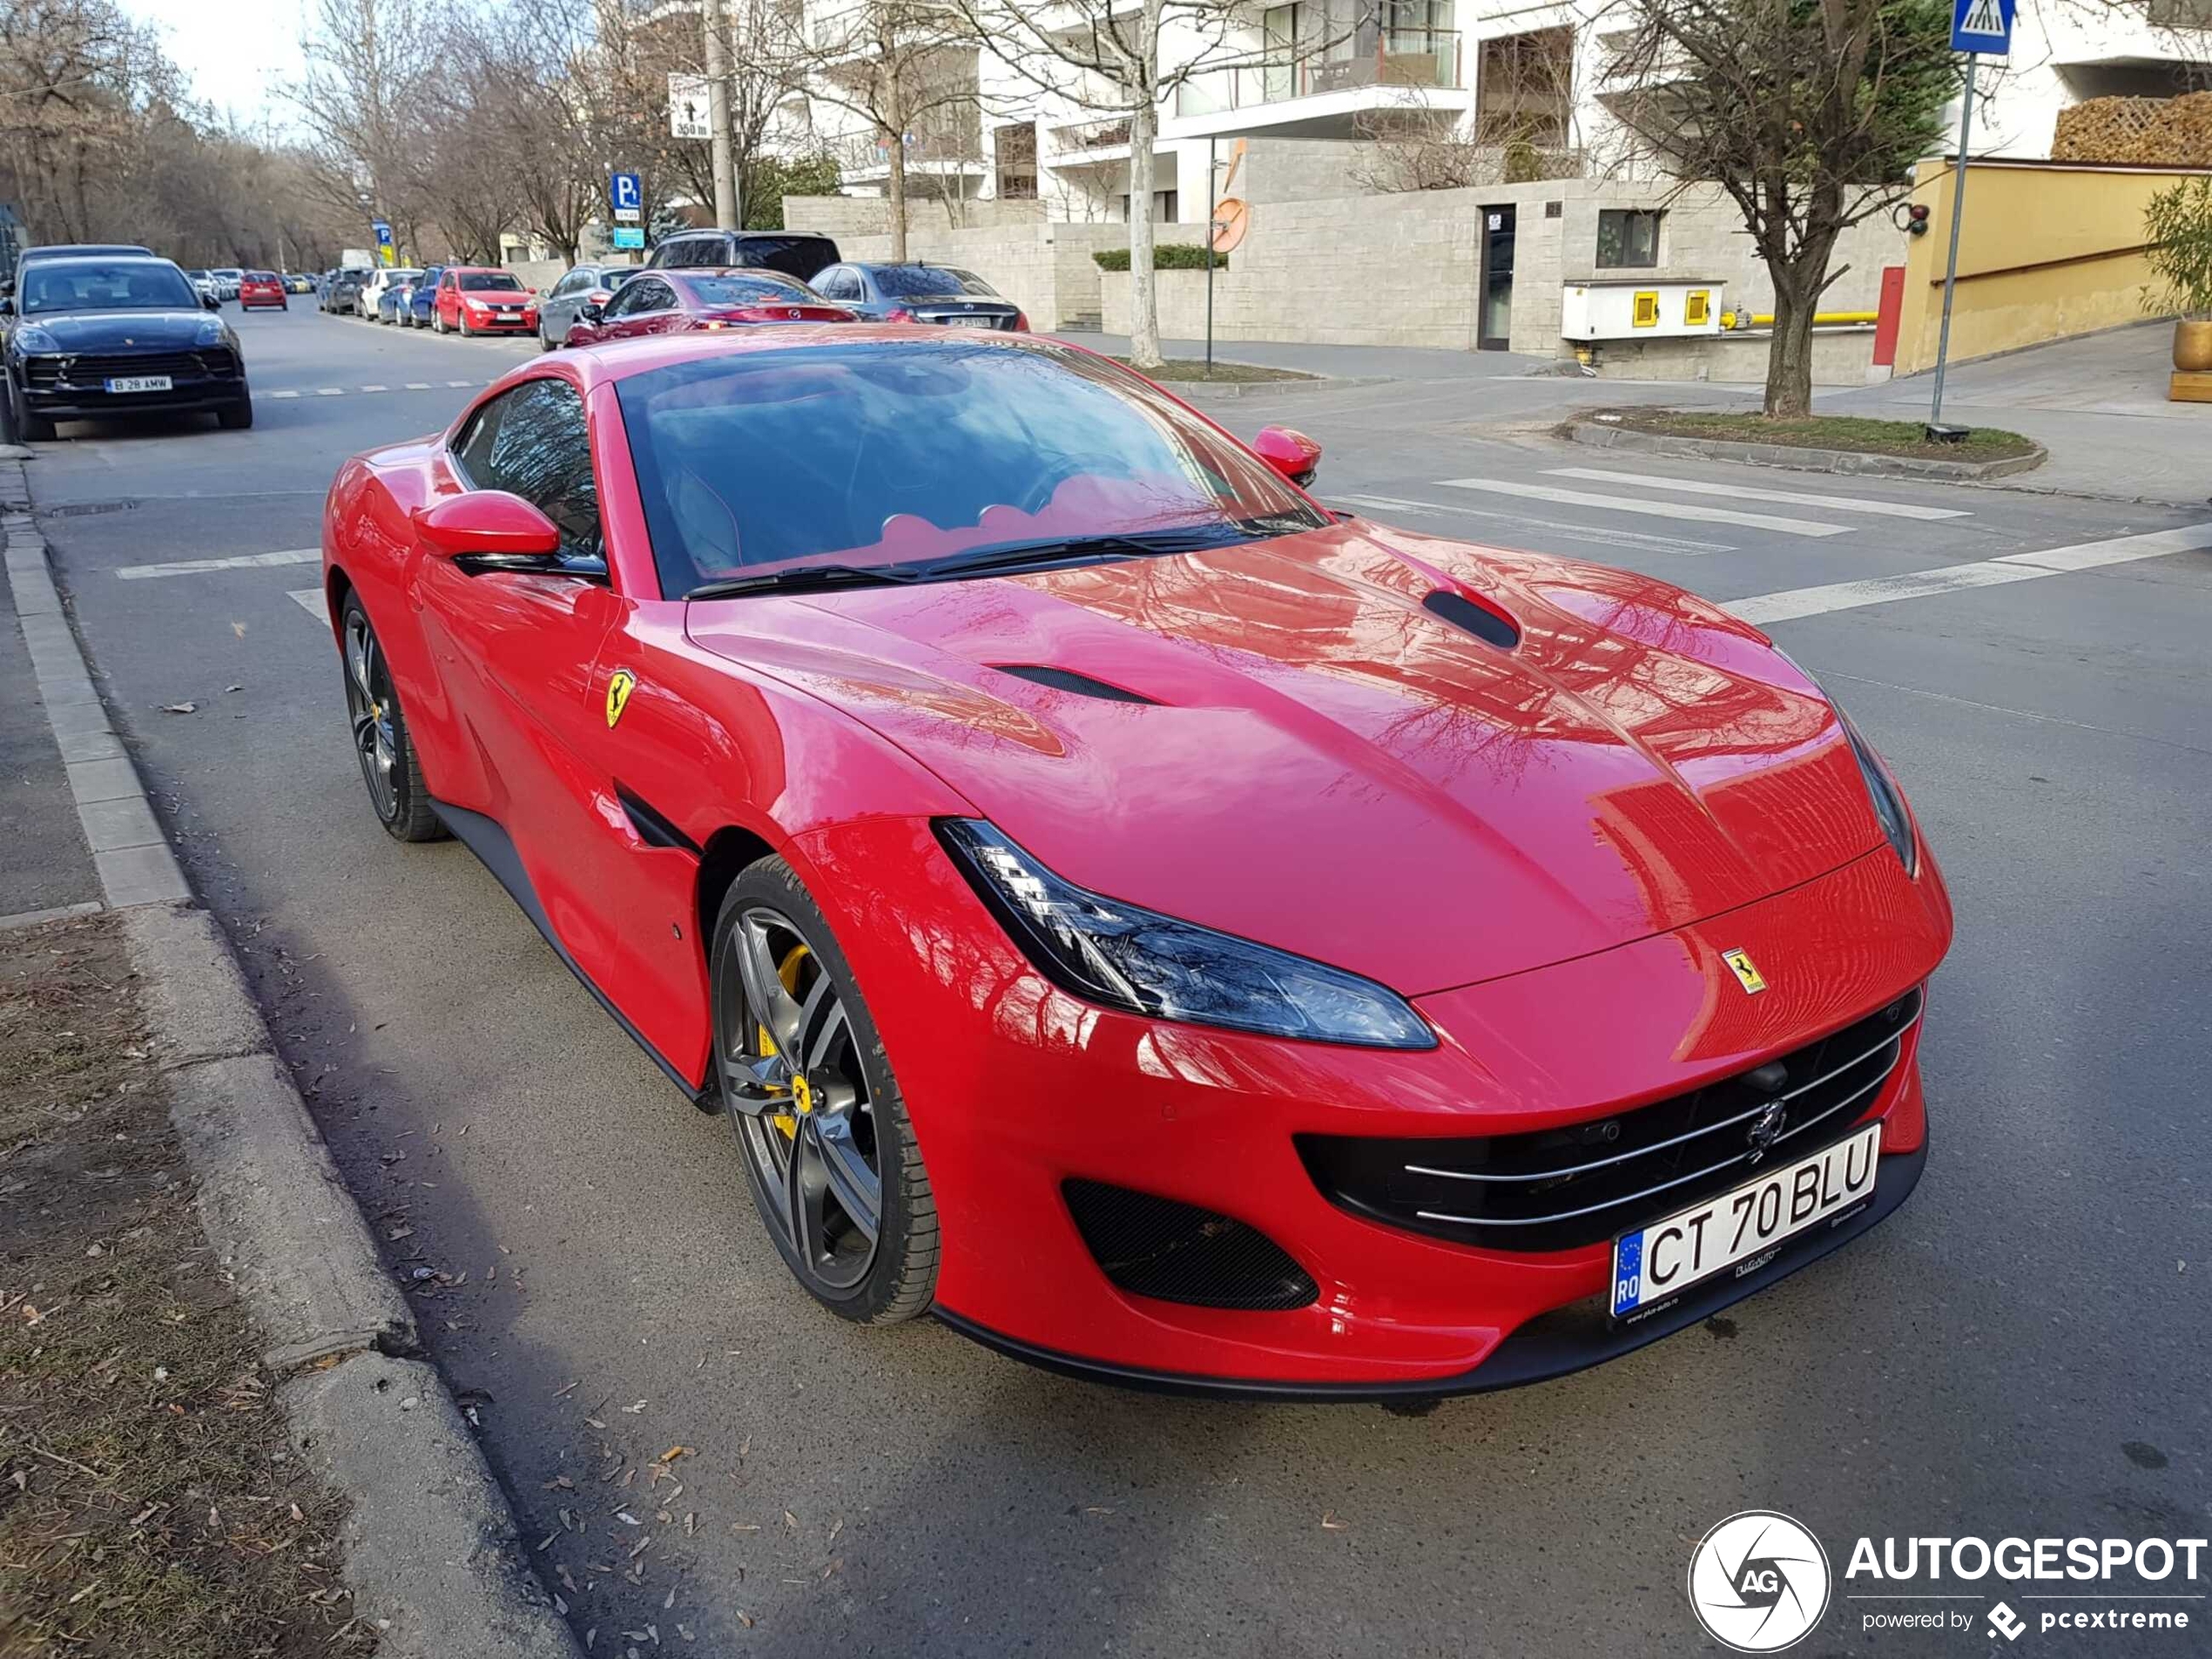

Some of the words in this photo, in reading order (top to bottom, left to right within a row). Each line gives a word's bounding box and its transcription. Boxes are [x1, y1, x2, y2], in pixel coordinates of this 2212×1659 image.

[677, 123, 696, 136] 350
[698, 125, 707, 136] m
[617, 176, 633, 206] P
[115, 380, 124, 390] B
[127, 380, 141, 389] 28
[145, 379, 166, 388] AMW
[1649, 1211, 1712, 1286] CT
[1729, 1182, 1781, 1254] 70
[1790, 1133, 1873, 1225] BLU
[1616, 1275, 1639, 1305] RO
